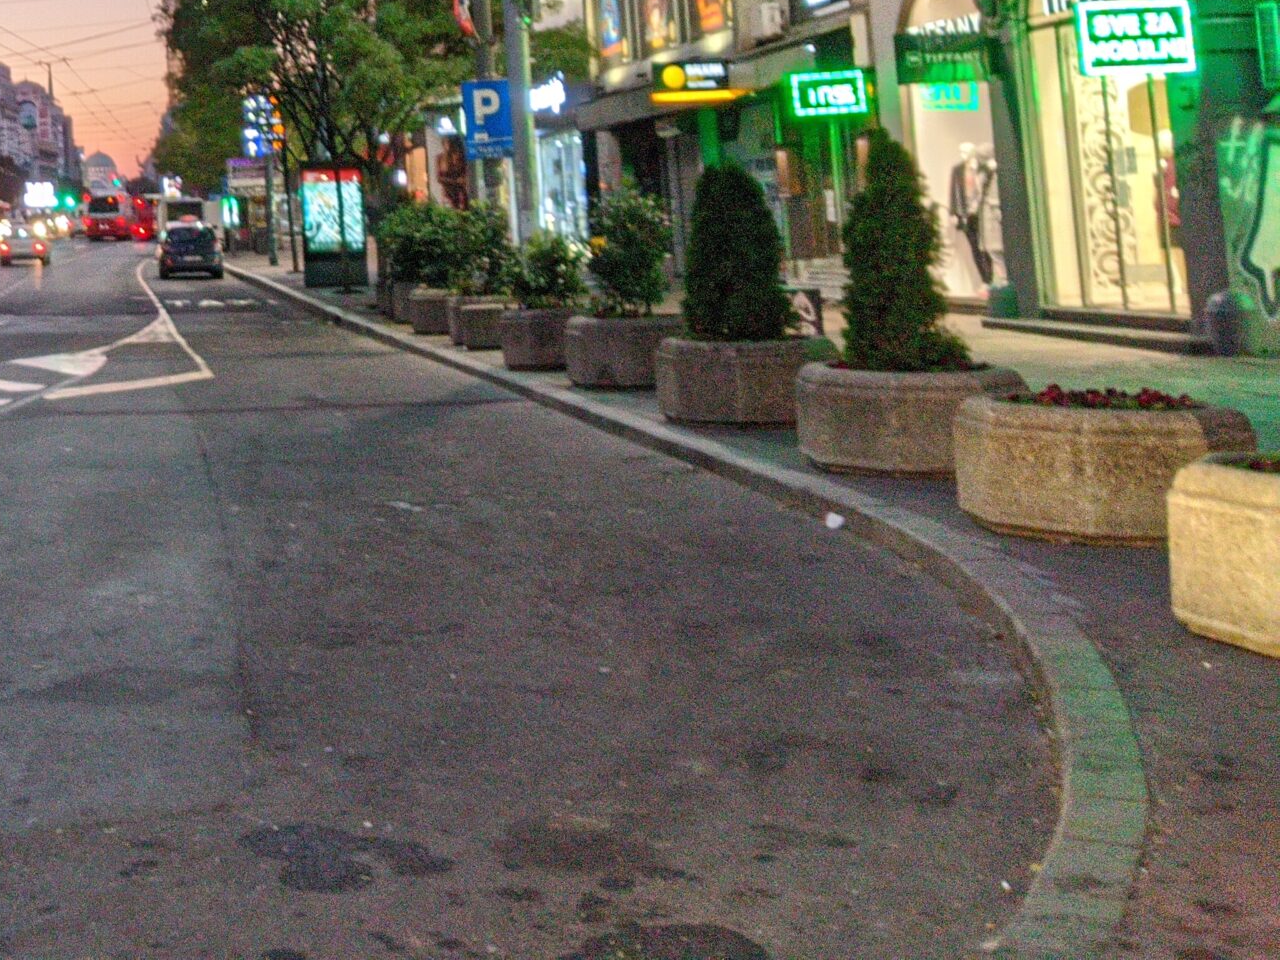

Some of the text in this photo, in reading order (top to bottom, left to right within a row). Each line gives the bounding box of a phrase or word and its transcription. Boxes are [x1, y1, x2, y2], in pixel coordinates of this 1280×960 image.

[1093, 11, 1177, 38] SVE ZA
[472, 88, 501, 125] P
